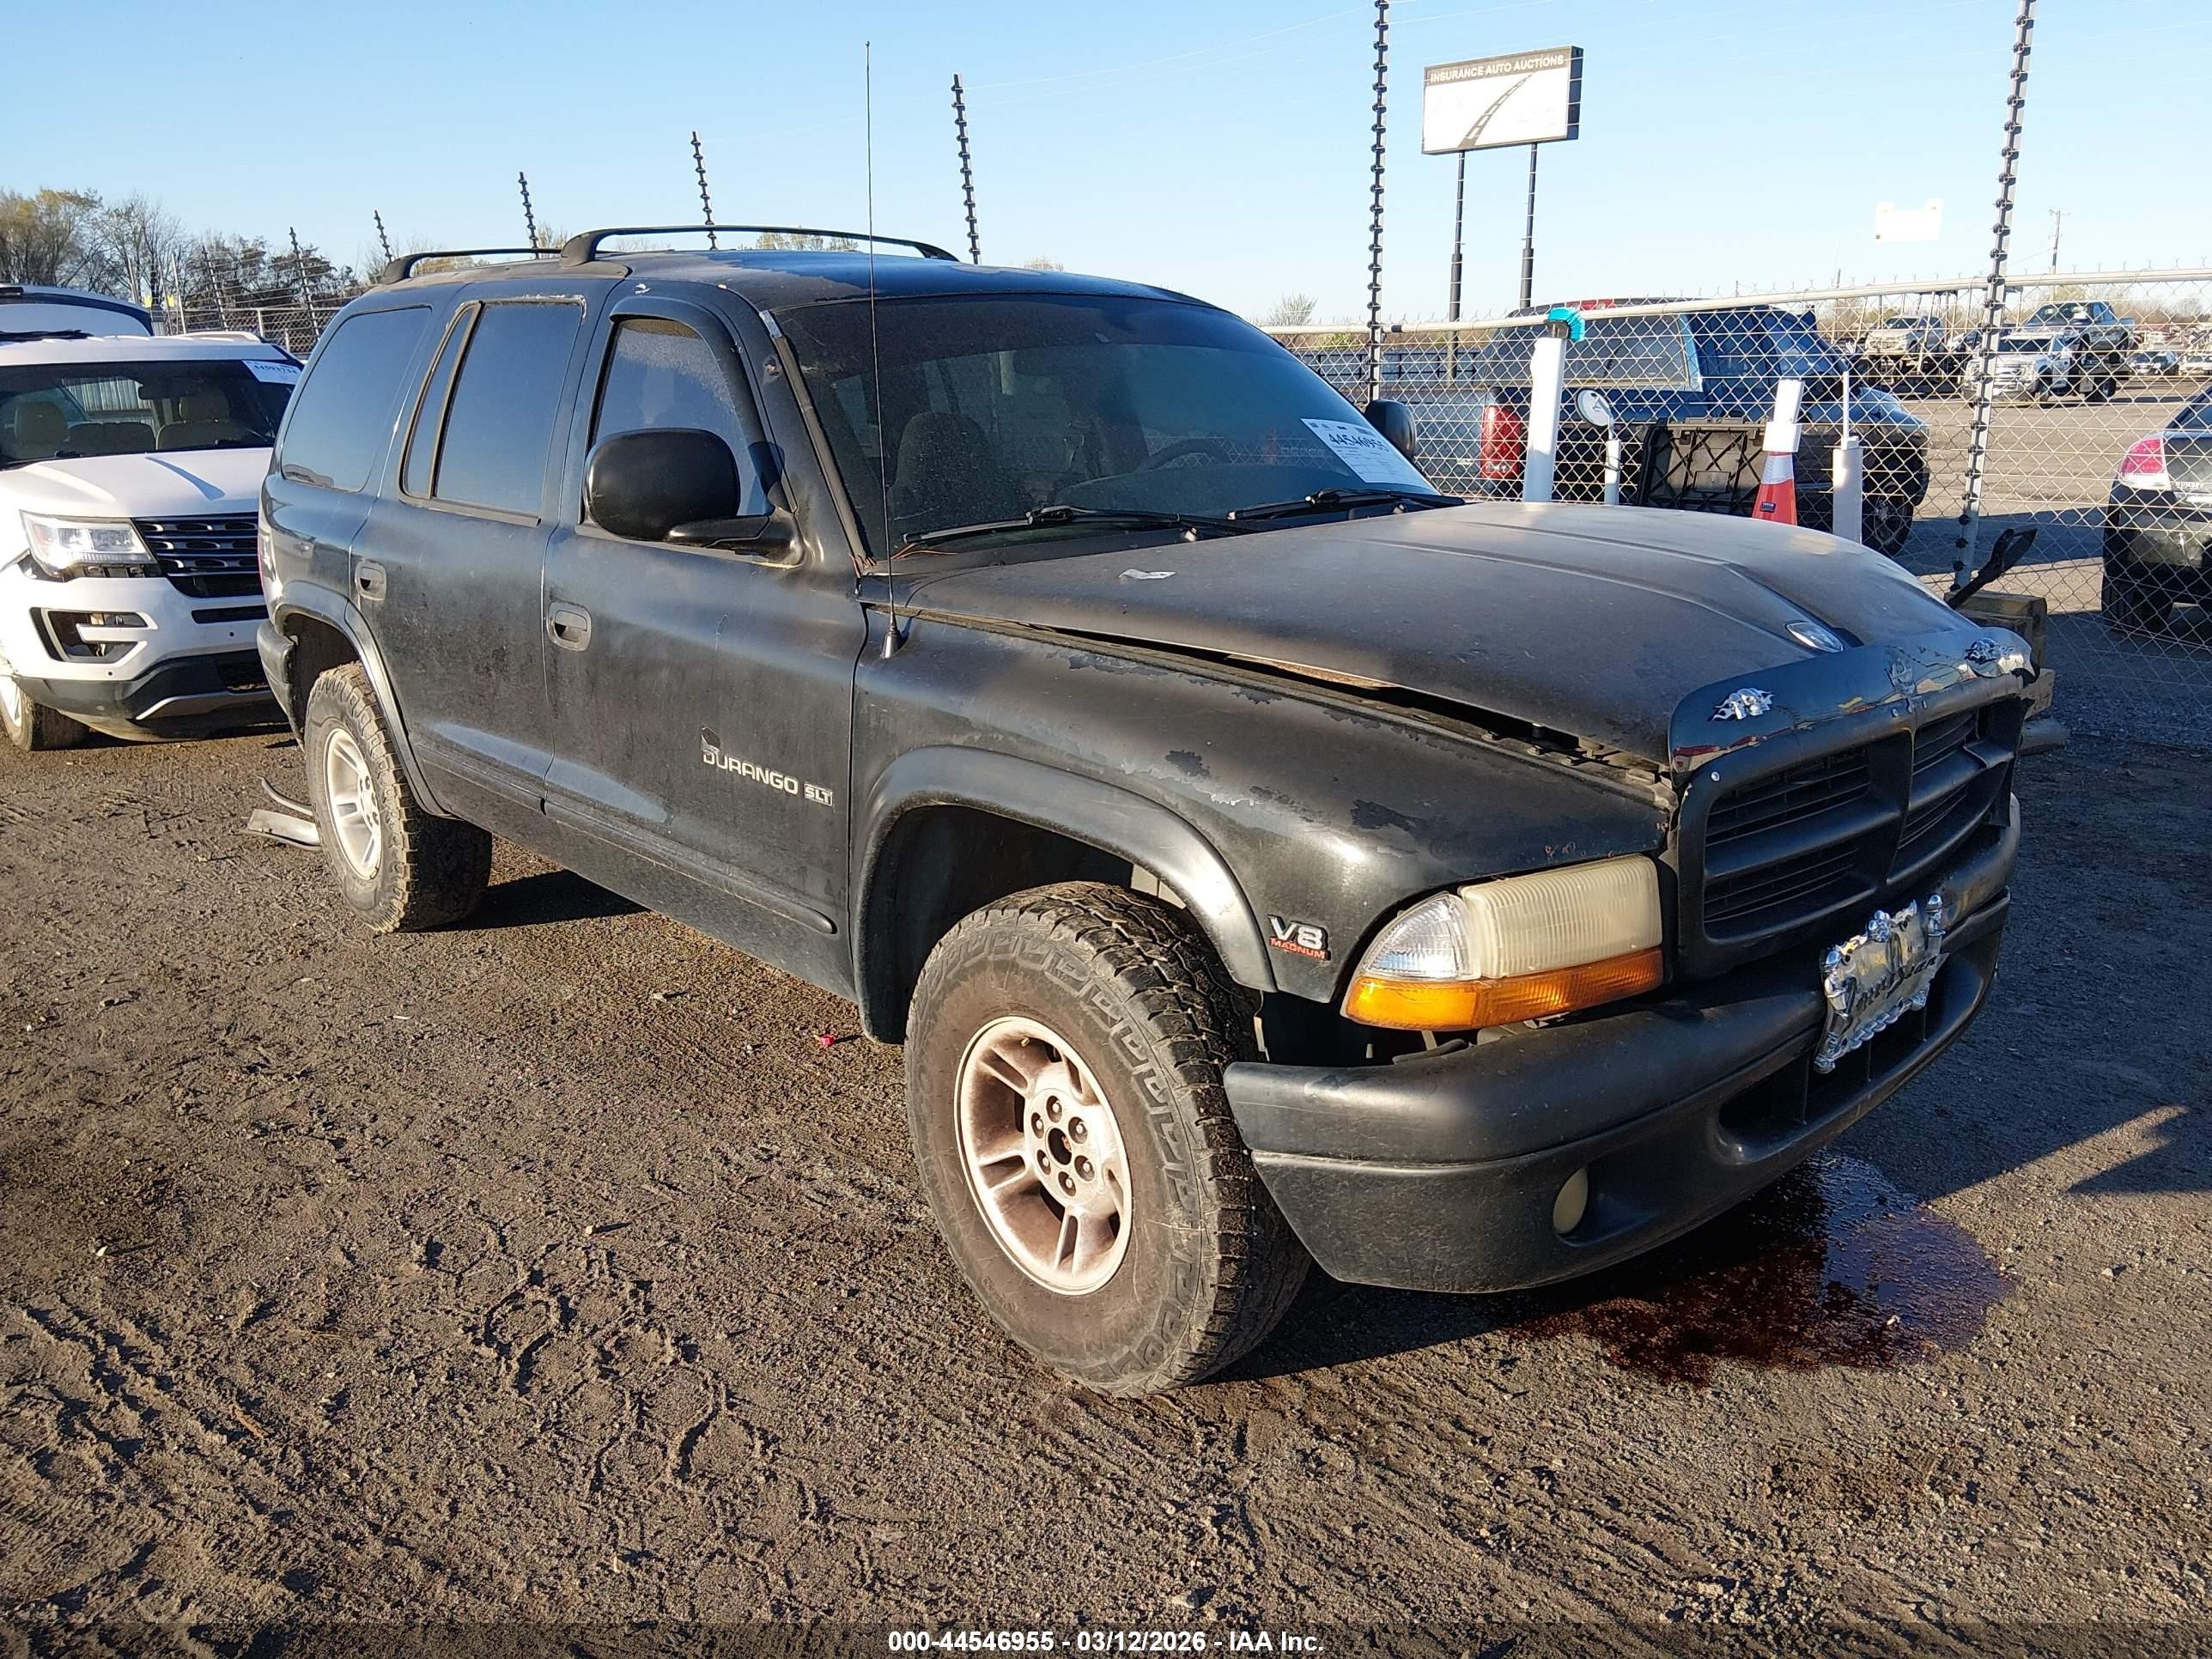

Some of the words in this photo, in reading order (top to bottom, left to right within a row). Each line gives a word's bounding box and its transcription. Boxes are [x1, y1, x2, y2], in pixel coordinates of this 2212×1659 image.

[1430, 66, 1485, 83] INSURANCE
[1486, 62, 1512, 76] AUTO
[1513, 54, 1565, 71] AUCTIONS
[1328, 433, 1390, 453] 44546955
[702, 749, 799, 795] DURANGO
[805, 786, 831, 805] SLT
[1267, 914, 1327, 951] V8
[1270, 938, 1327, 960] MAGNUM
